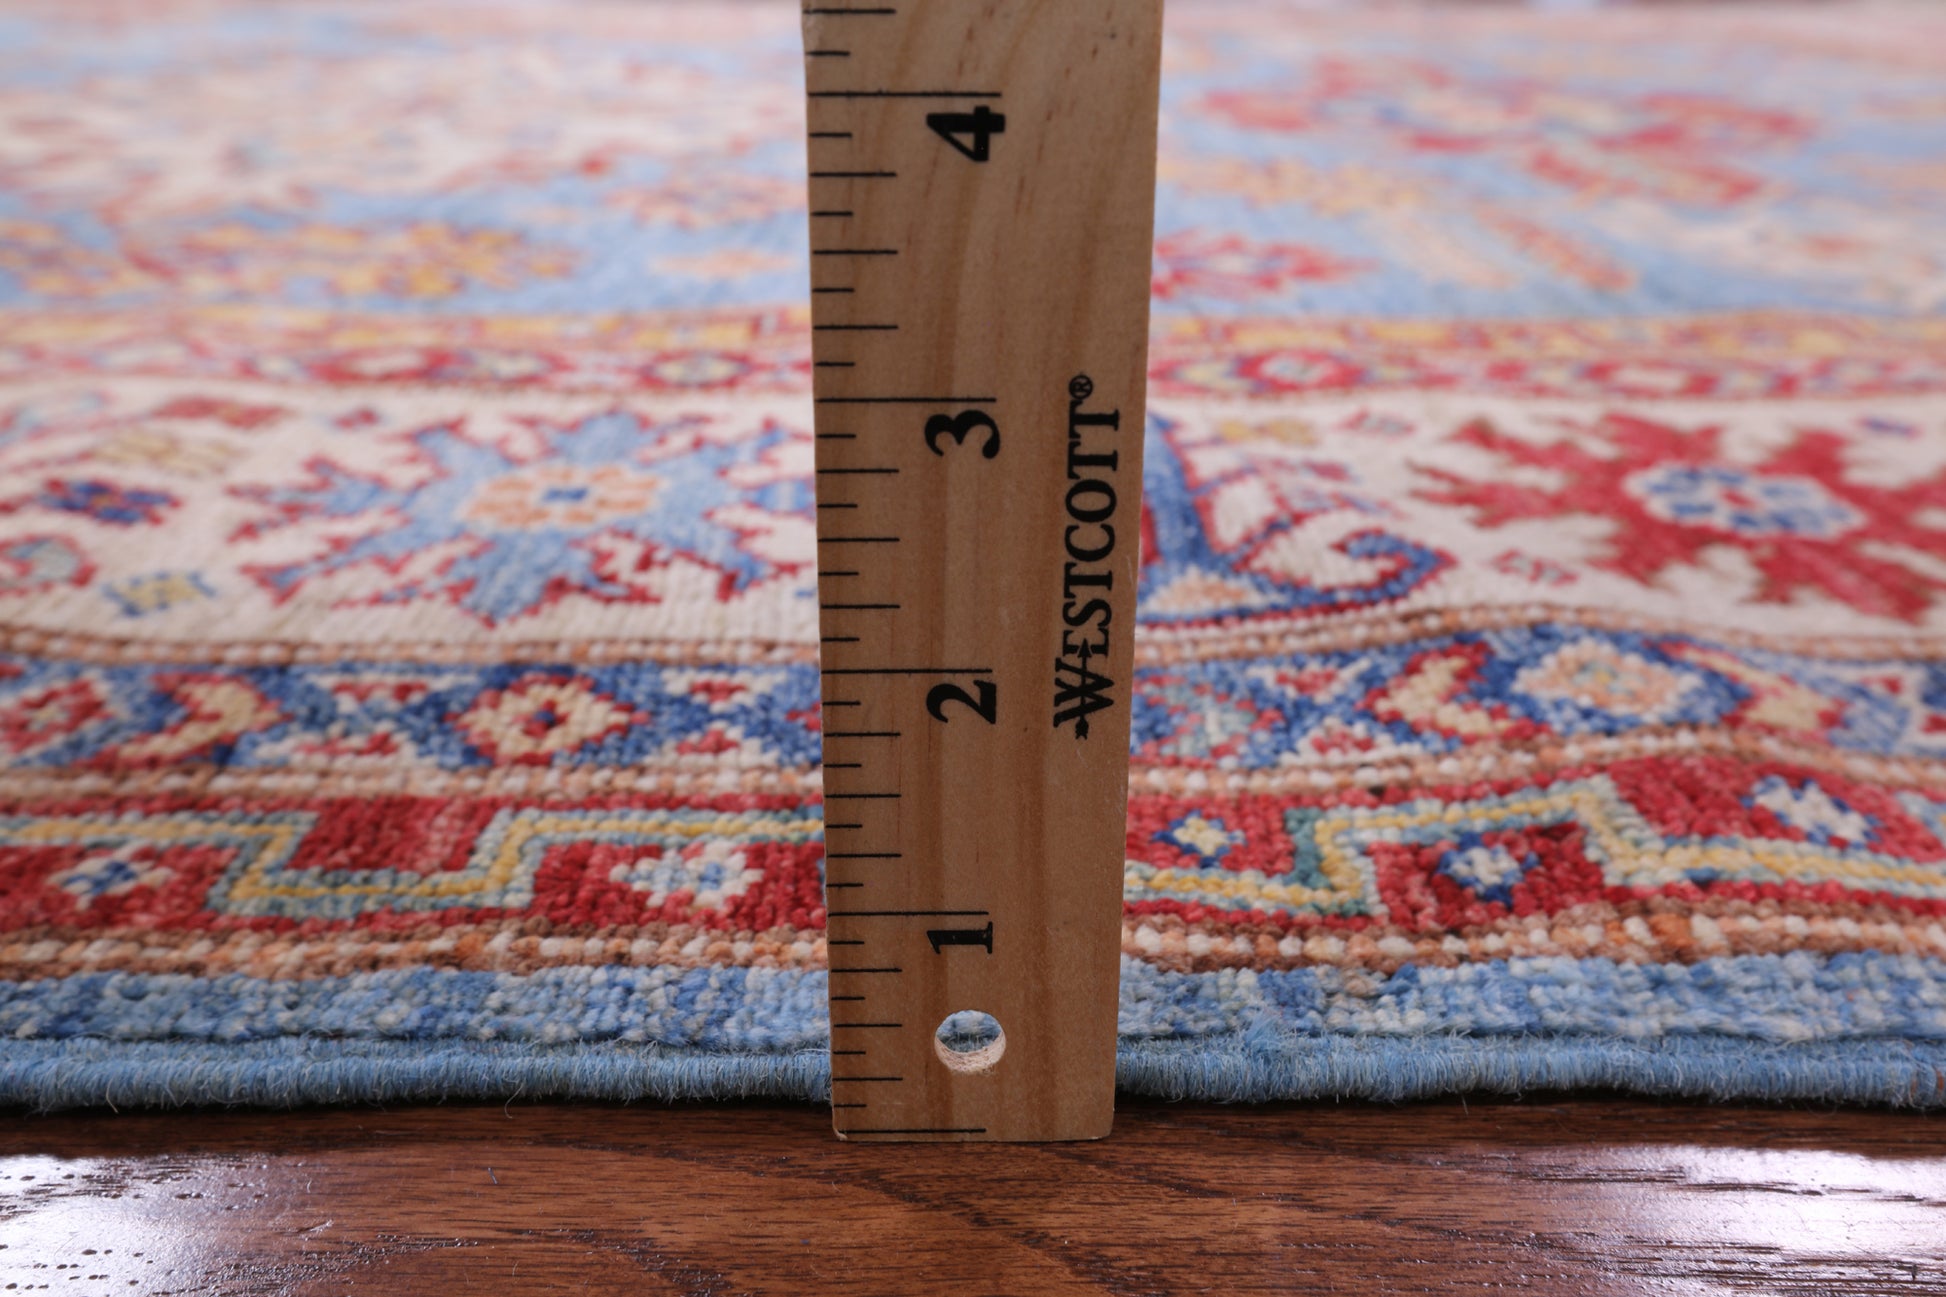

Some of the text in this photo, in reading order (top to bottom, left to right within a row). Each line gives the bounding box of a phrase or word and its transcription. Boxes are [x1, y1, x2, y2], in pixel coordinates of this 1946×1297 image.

[926, 105, 1006, 163] 4
[923, 409, 1001, 460] 3
[925, 679, 997, 725] 2
[926, 921, 994, 954] 1
